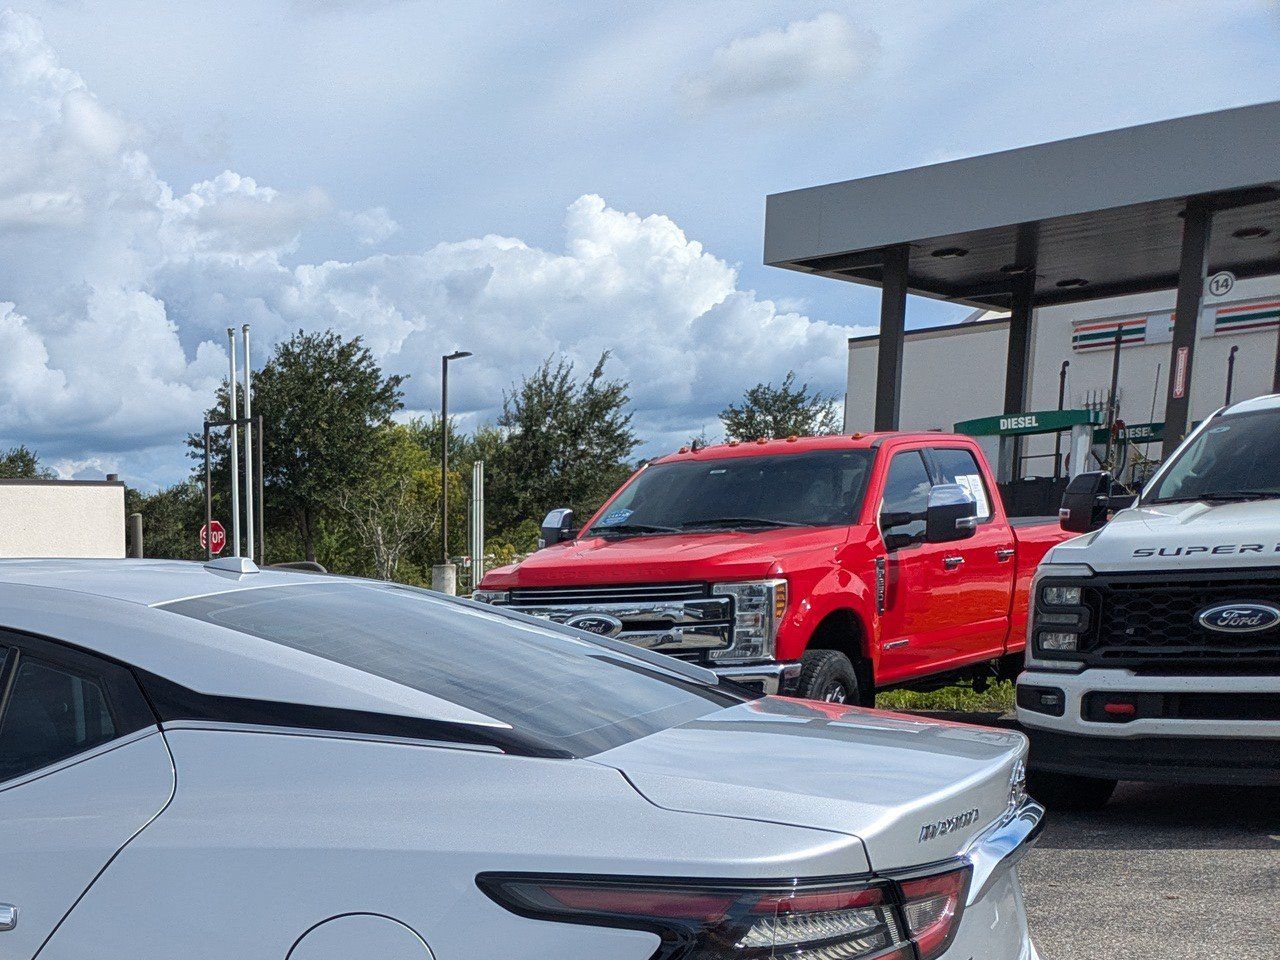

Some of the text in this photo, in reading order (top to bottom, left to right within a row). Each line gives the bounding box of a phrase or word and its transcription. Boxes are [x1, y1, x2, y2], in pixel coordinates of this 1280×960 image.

[1213, 278, 1230, 292] 14
[999, 415, 1039, 431] DIESEL
[202, 531, 224, 544] SOP
[1133, 543, 1265, 558] SUPER
[1217, 609, 1263, 626] Ford
[579, 620, 605, 634] Ford
